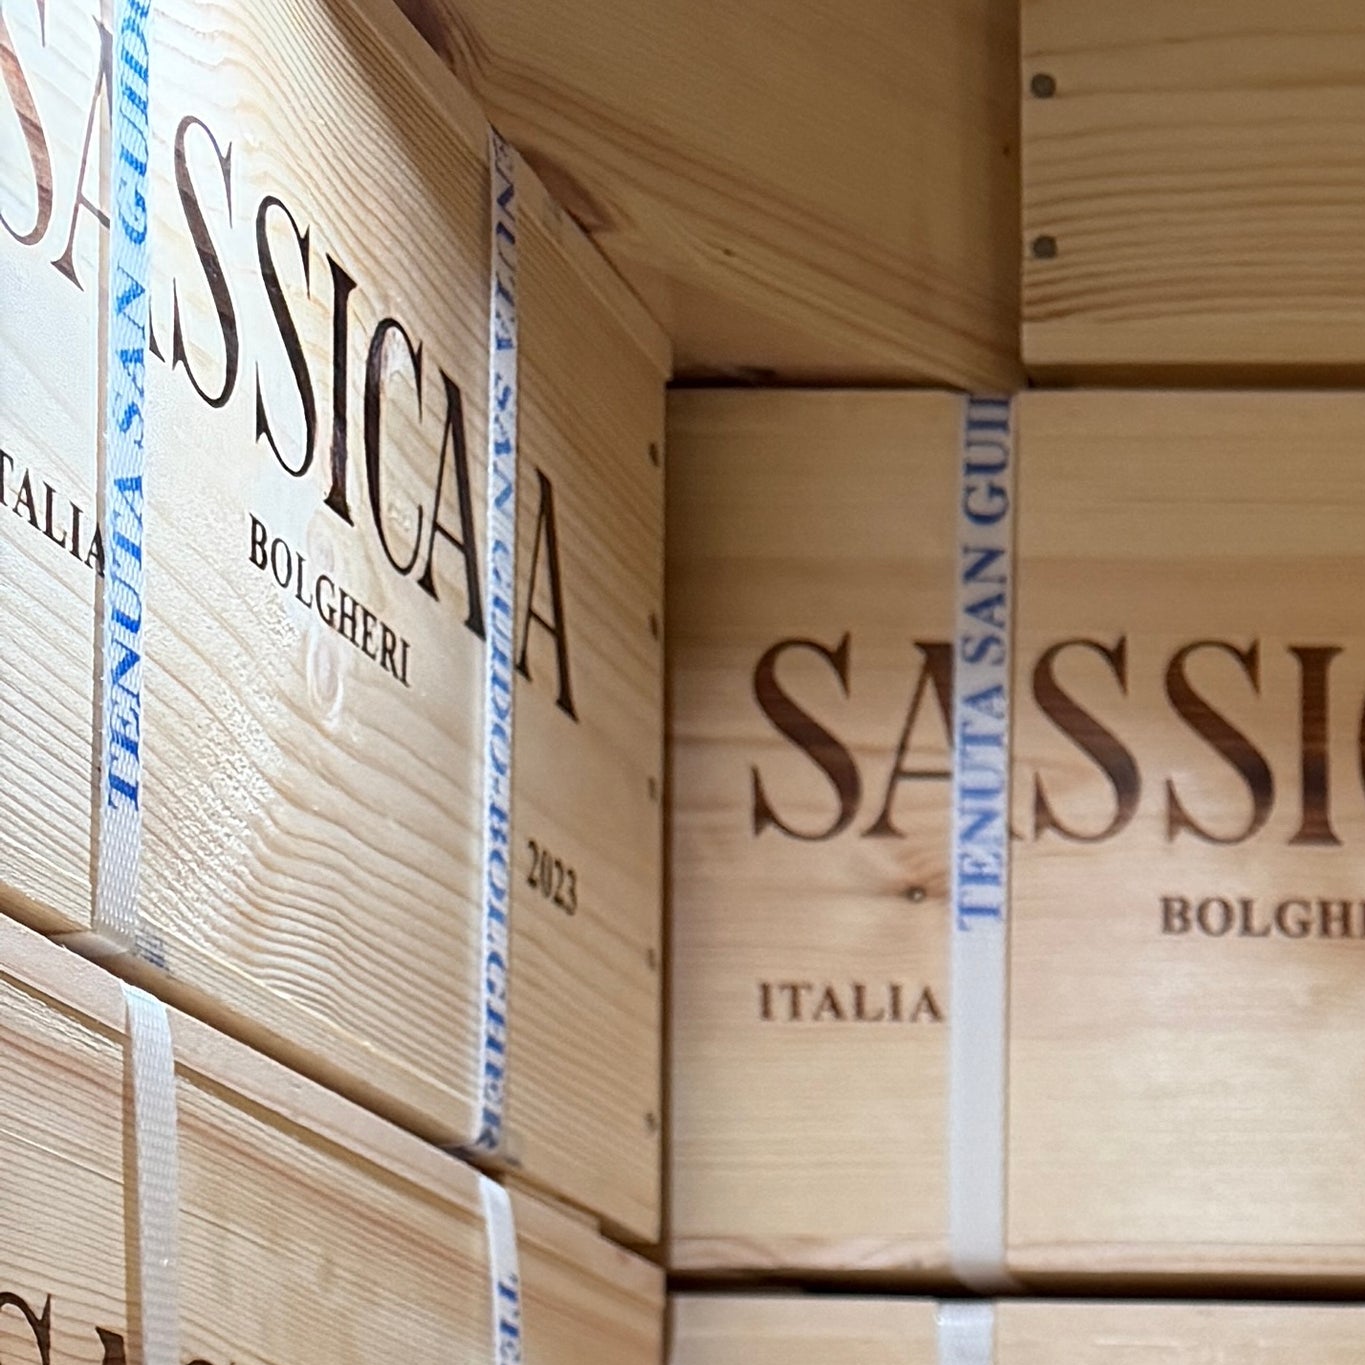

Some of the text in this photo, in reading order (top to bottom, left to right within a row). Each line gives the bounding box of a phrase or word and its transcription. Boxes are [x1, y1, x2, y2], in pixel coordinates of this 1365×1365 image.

[113, 267, 147, 450] SAN
[493, 372, 513, 508] SAN
[106, 476, 143, 812] TENUTA
[248, 512, 411, 688] BOLGHERI
[963, 547, 1007, 669] SAN
[527, 838, 579, 917] 2023
[959, 690, 1007, 930] TENUTA
[758, 981, 945, 1023] ITALIA
